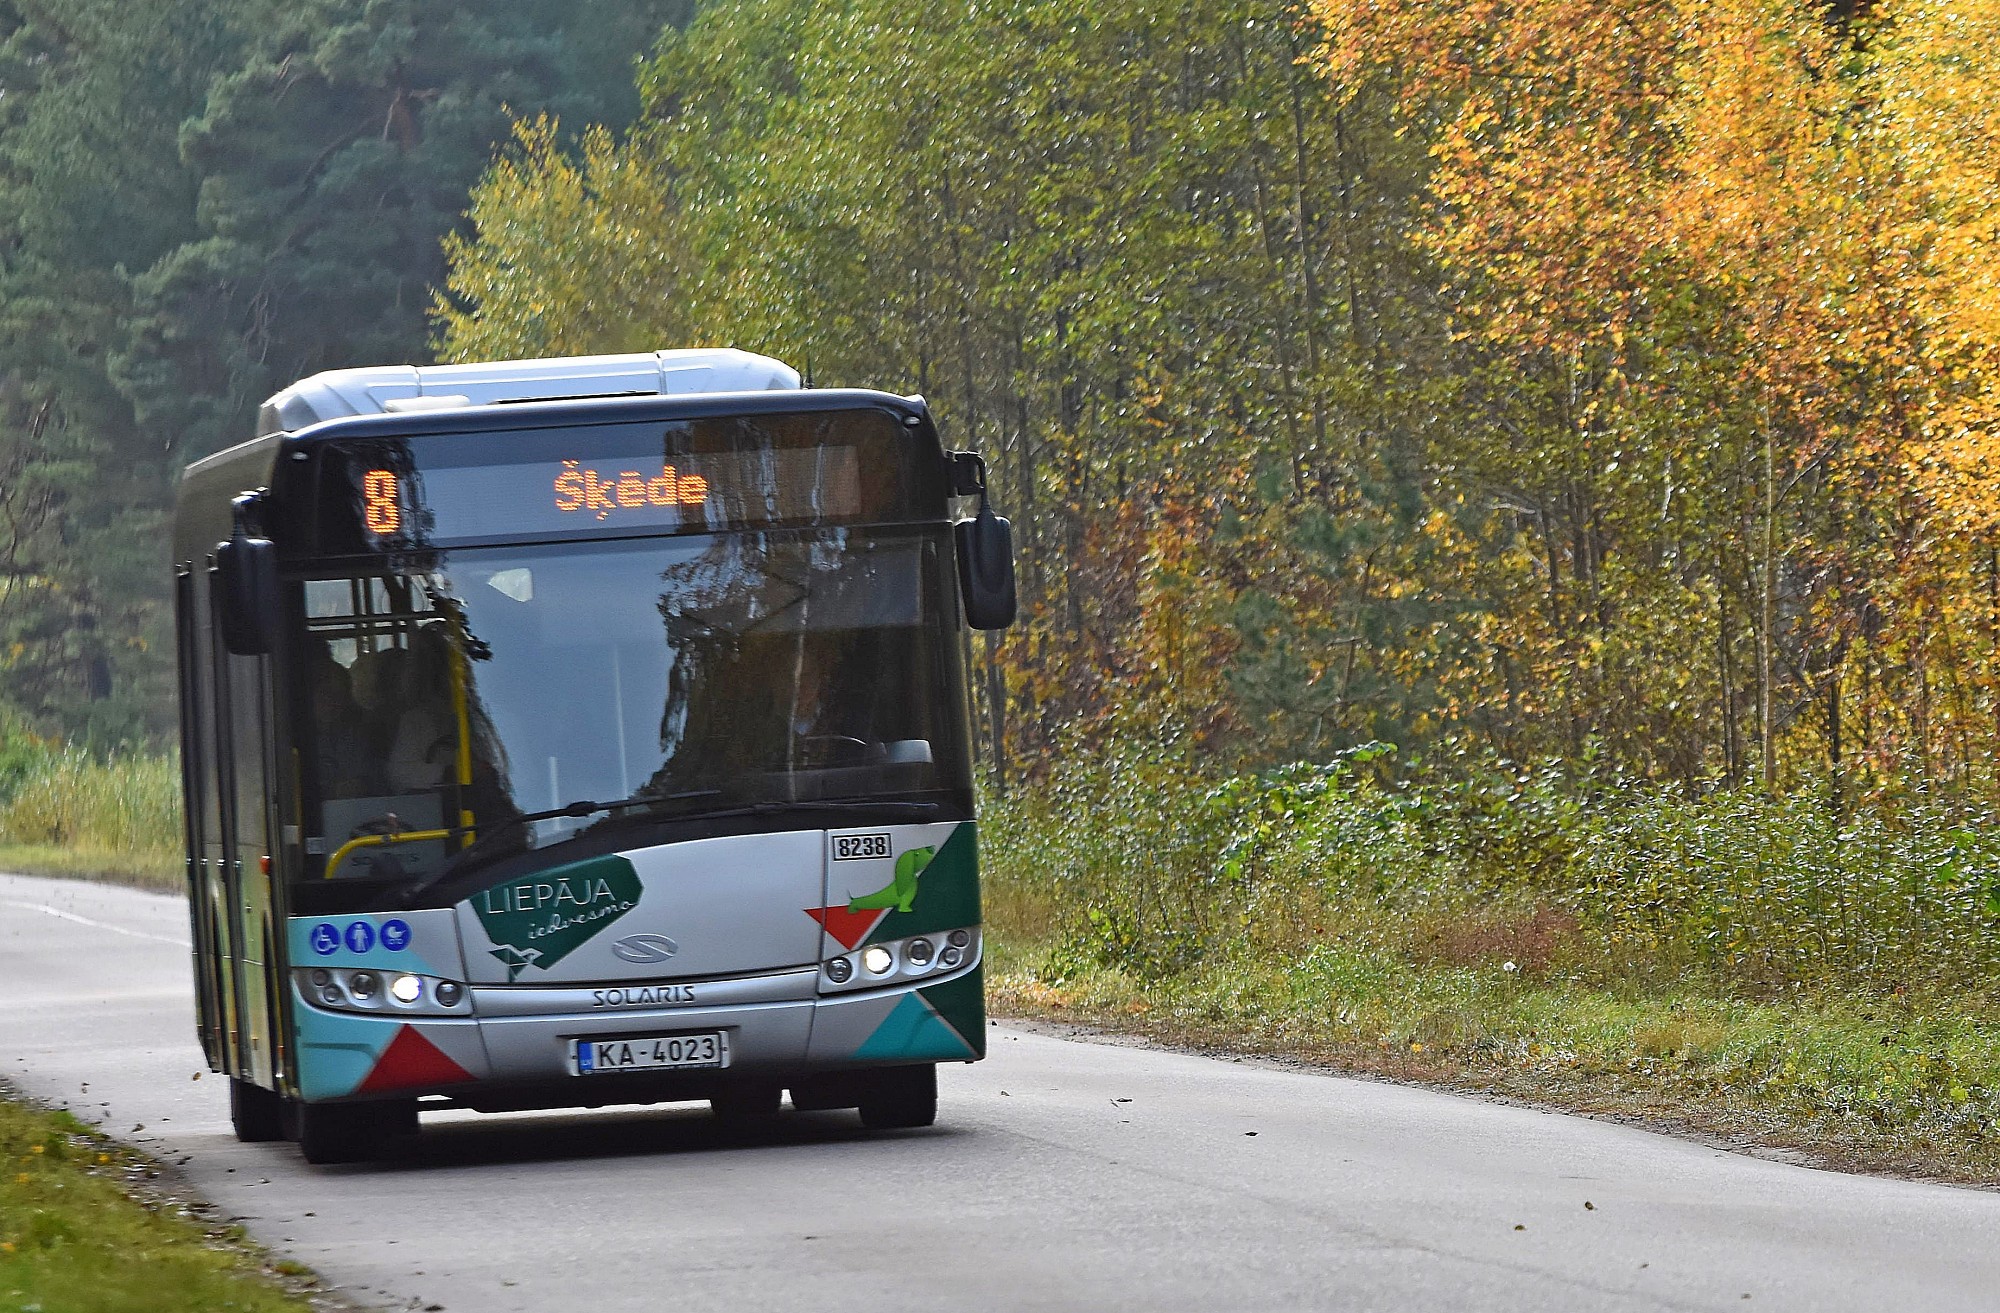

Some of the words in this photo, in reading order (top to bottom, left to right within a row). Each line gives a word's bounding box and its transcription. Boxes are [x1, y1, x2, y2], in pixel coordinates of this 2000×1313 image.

[364, 469, 400, 534] 8
[555, 459, 708, 521] Šķēde
[839, 836, 886, 857] 8238
[484, 877, 616, 914] LIEPĀJA
[593, 986, 695, 1007] SOLARIS
[599, 1037, 716, 1067] KA-4023
